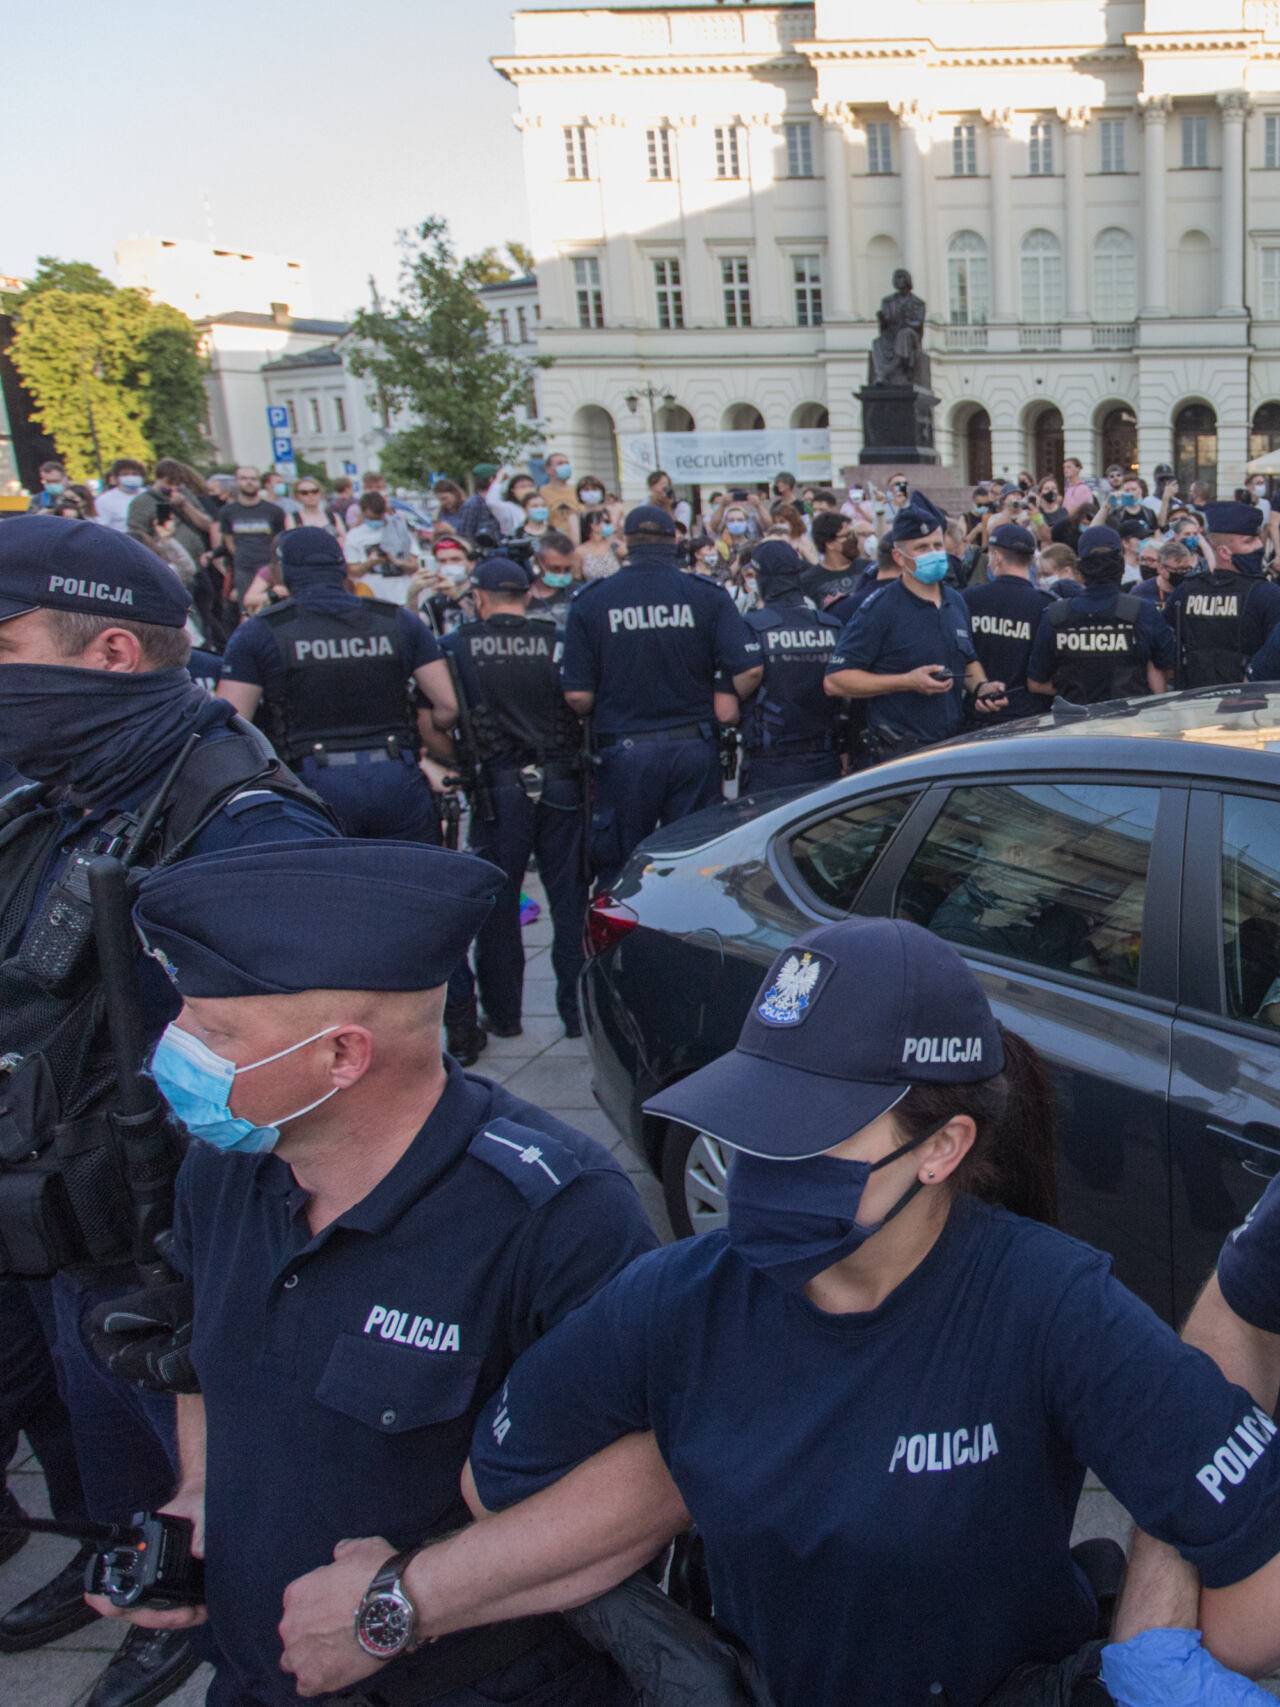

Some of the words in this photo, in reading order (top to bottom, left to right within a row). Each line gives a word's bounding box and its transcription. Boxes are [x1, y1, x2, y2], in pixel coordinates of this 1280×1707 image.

[272, 410, 285, 425] P
[276, 440, 290, 457] P
[675, 450, 785, 469] recruitment
[48, 575, 134, 606] POLICJA
[1185, 594, 1238, 617] POLICJA
[608, 603, 695, 633] POLICJA
[971, 615, 1031, 640] POLICJA
[294, 635, 394, 661] POLICJA
[470, 635, 549, 657] POLICJA
[766, 629, 836, 649] POLICJA
[1056, 632, 1128, 651] POLICJA
[902, 1037, 982, 1063] POLICJA
[364, 1305, 460, 1352] POLICJA
[889, 1422, 999, 1474] POLICJA
